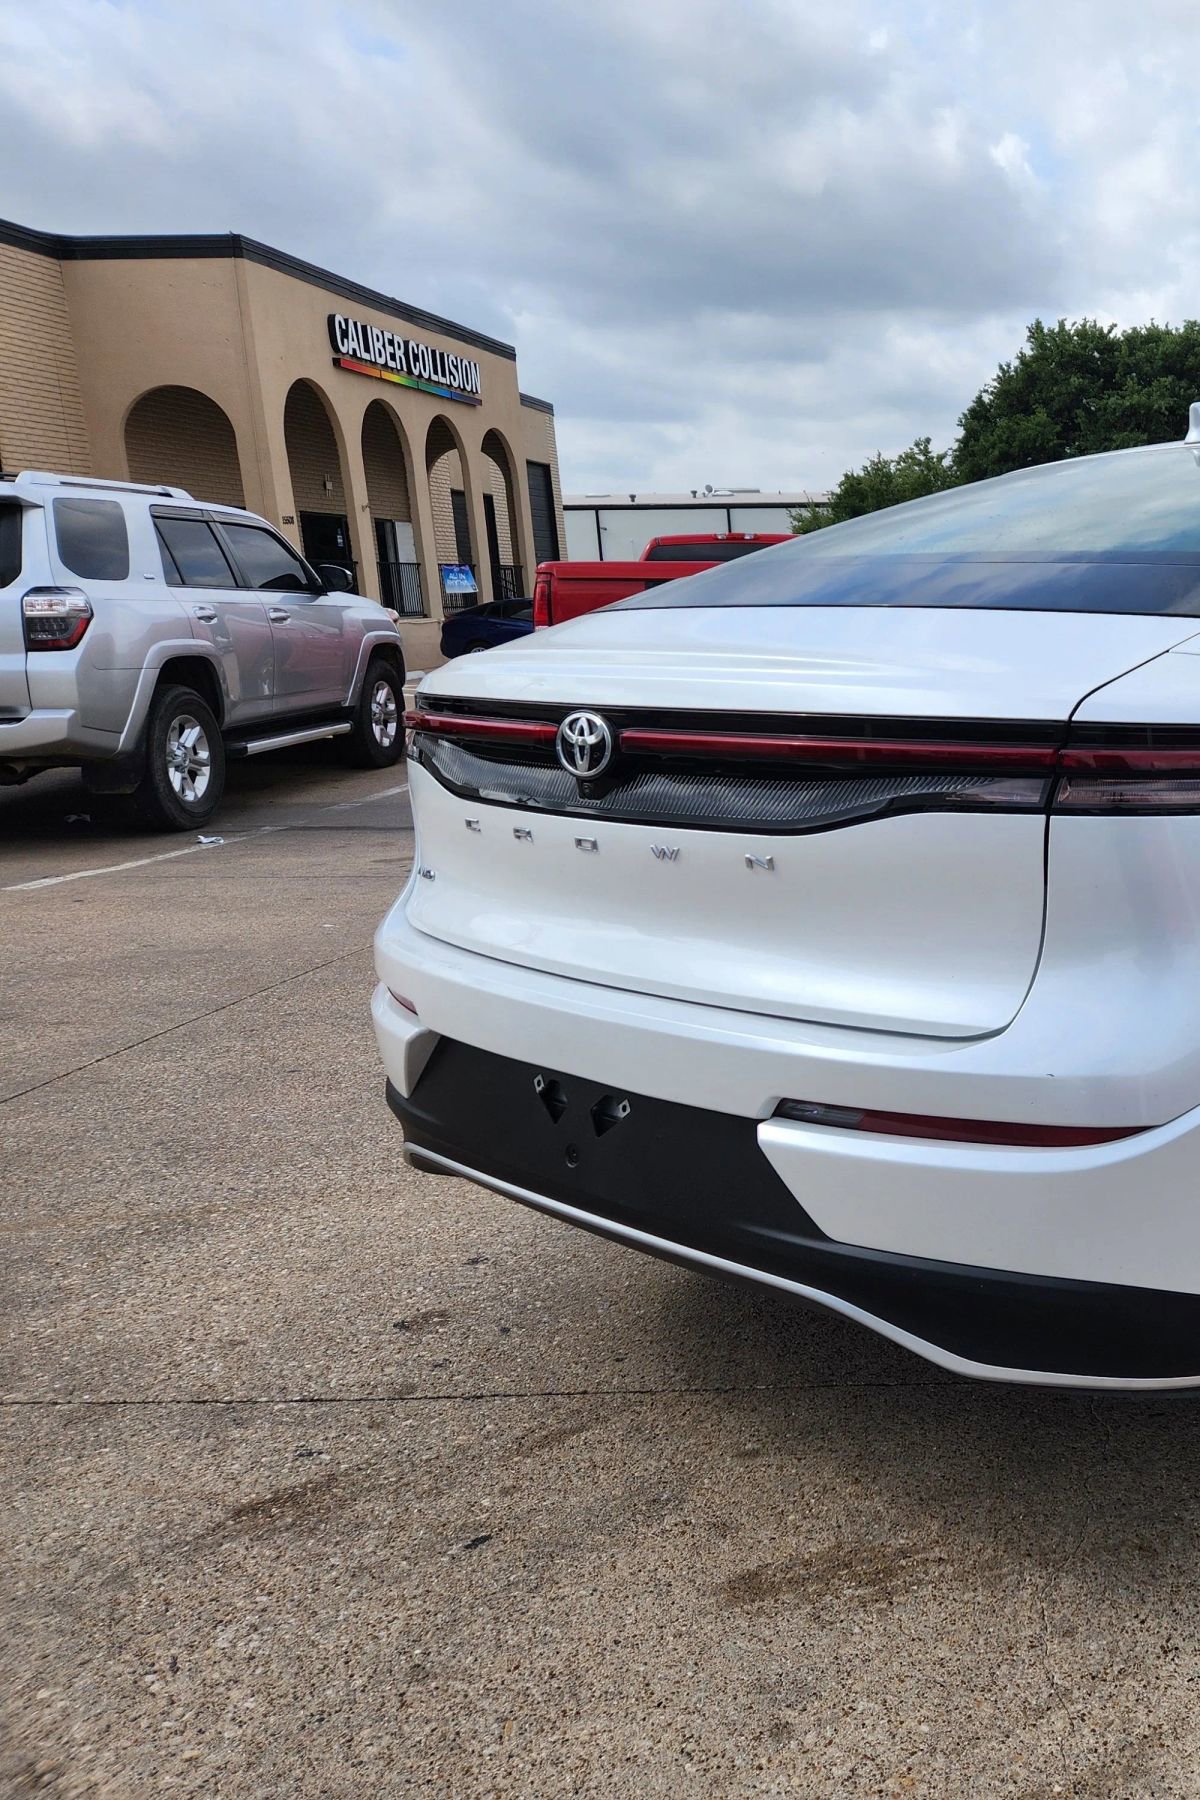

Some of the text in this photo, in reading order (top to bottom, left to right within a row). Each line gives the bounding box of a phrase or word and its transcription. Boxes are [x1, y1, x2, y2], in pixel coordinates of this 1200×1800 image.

[334, 313, 481, 394] CALIBER COLLISION
[464, 817, 775, 871] CROWN
